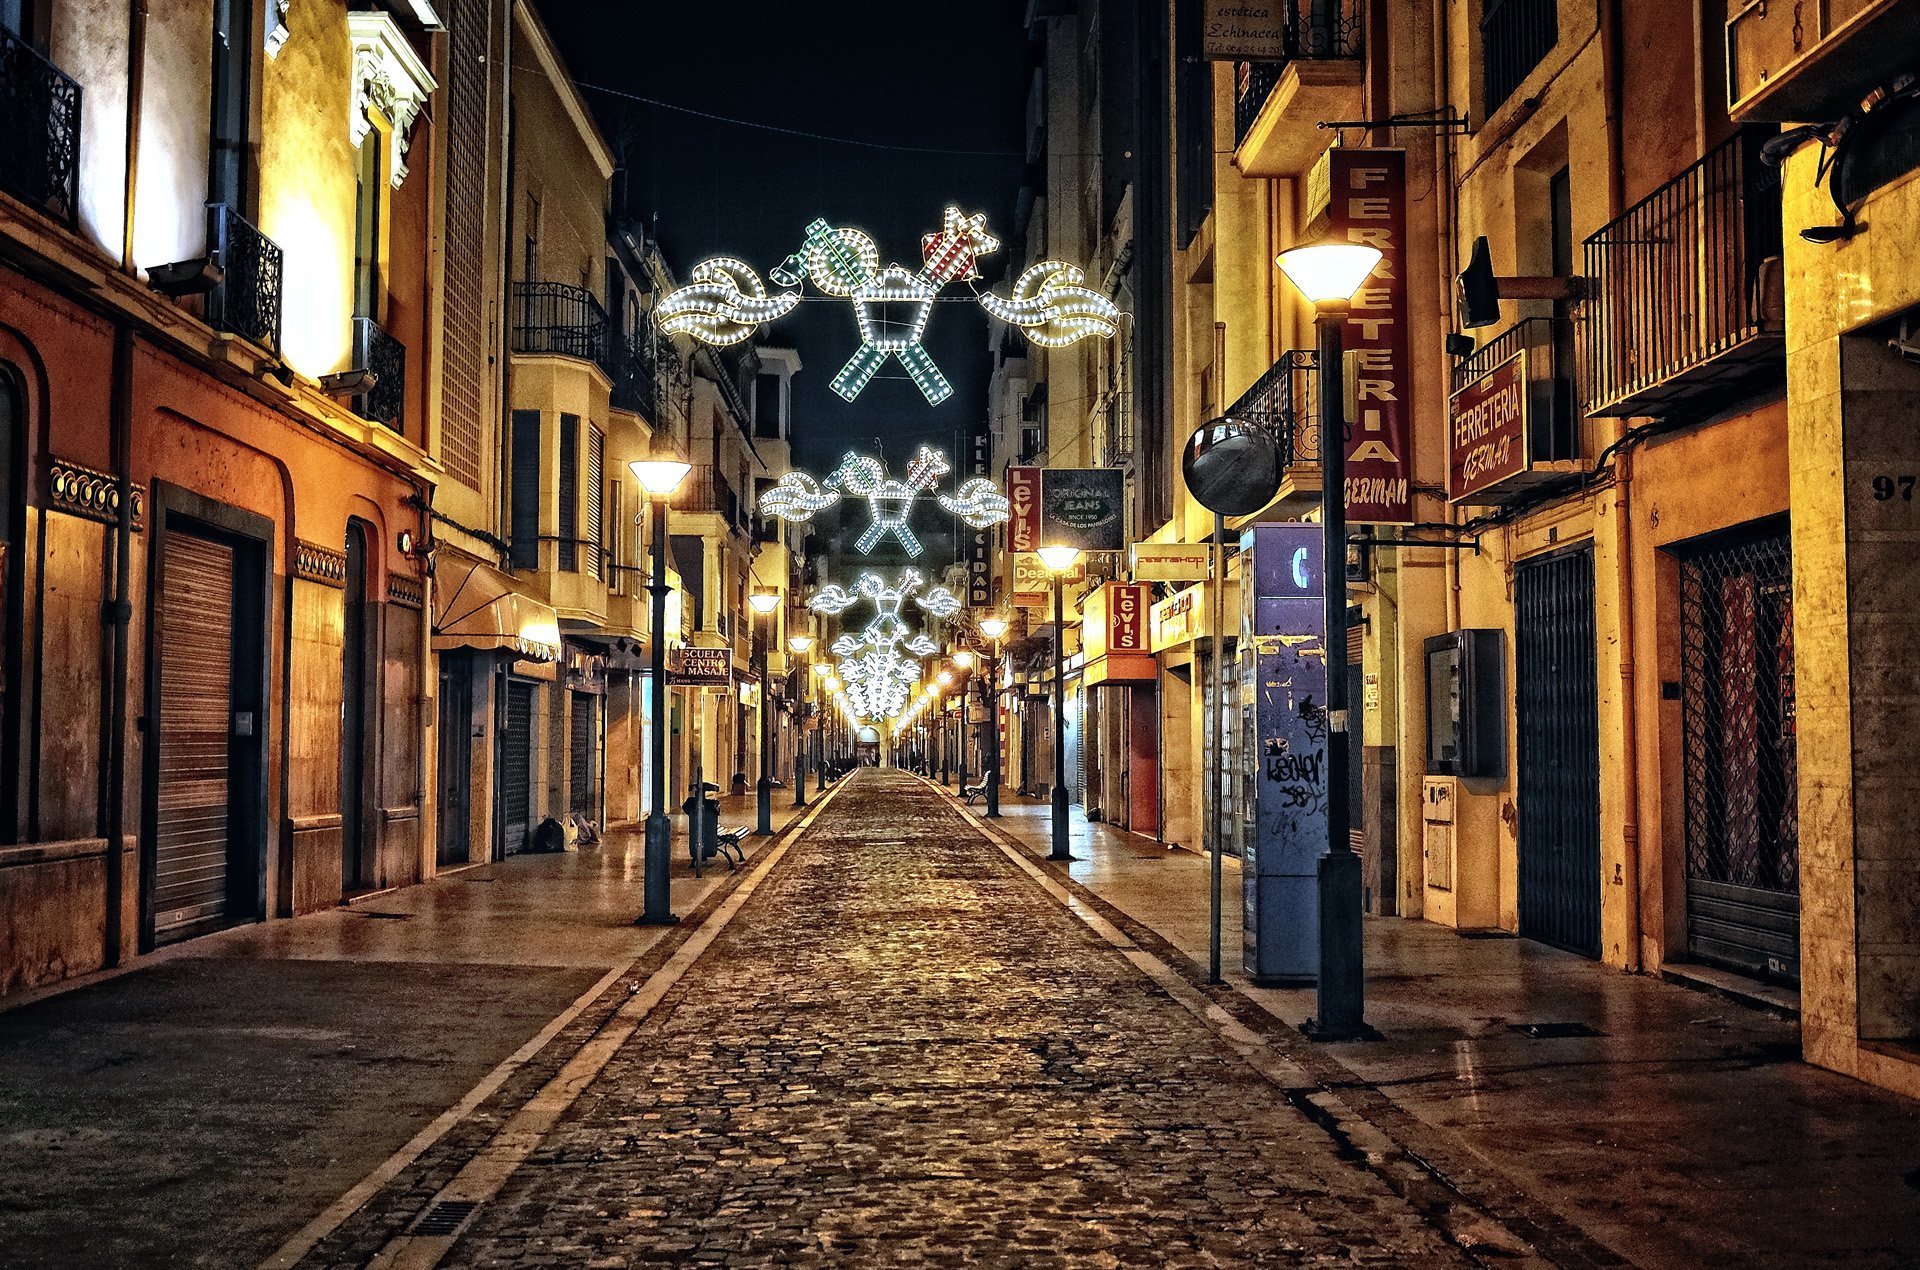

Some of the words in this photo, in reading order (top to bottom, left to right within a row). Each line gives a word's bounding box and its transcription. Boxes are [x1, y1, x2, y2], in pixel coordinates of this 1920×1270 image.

[1207, 23, 1280, 39] Echinacea
[1455, 383, 1520, 450] FERRETERIA
[1463, 434, 1510, 490] GERMAN
[1053, 488, 1110, 499] ORIGINAL
[1344, 477, 1407, 509] GERMAN
[1872, 475, 1917, 501] 97
[1064, 500, 1101, 511] JEANS
[973, 435, 987, 601] ELECIDAD
[1055, 517, 1069, 527] CASA
[685, 659, 726, 667] CENTRO
